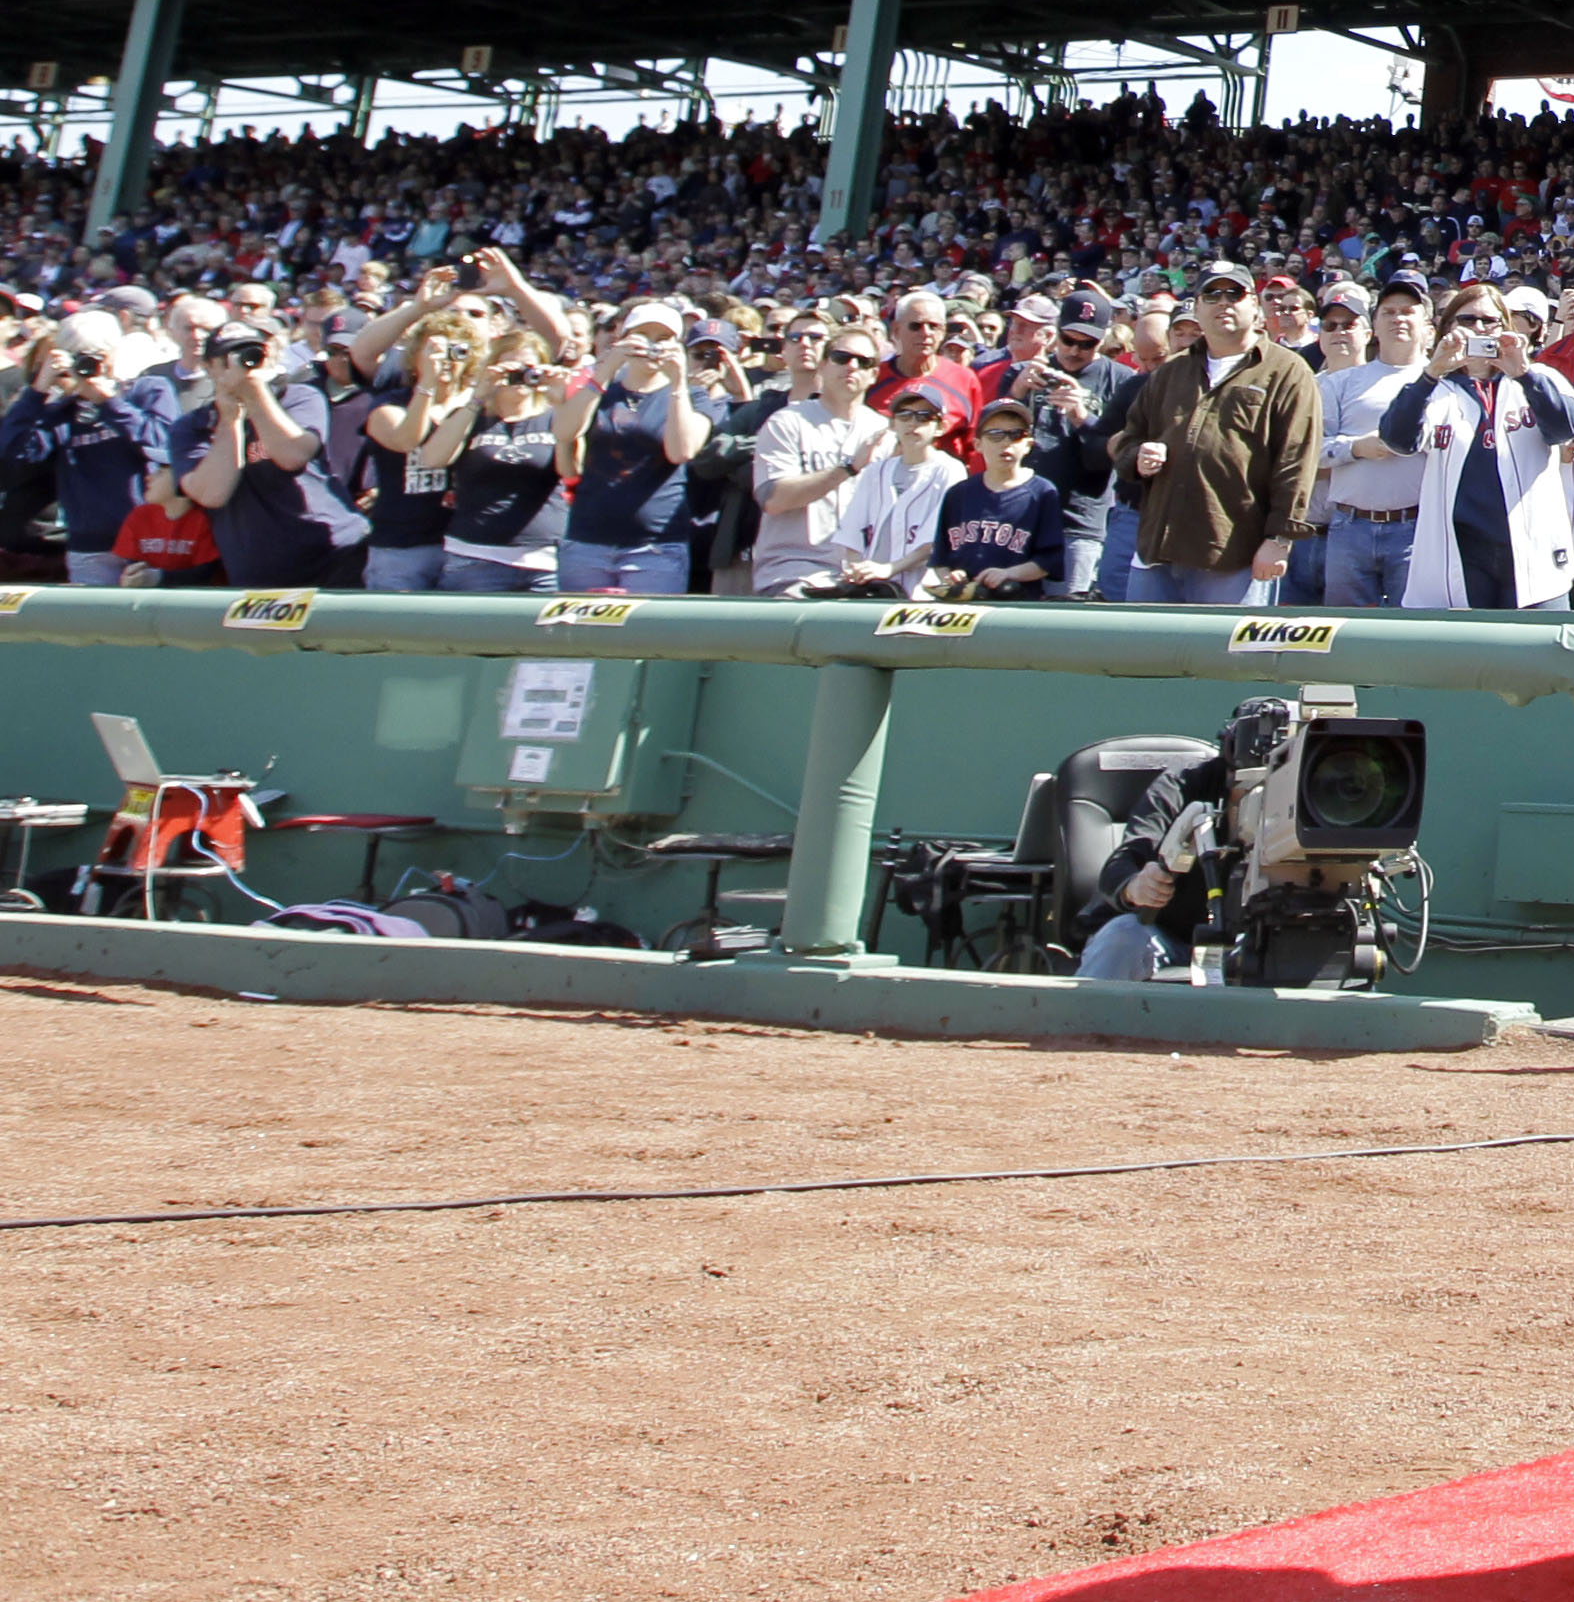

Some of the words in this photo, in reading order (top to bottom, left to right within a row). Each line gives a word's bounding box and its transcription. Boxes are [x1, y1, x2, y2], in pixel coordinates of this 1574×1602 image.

[230, 597, 308, 621] Nikon
[885, 607, 977, 628] Nikon
[1236, 619, 1334, 645] Nikon
